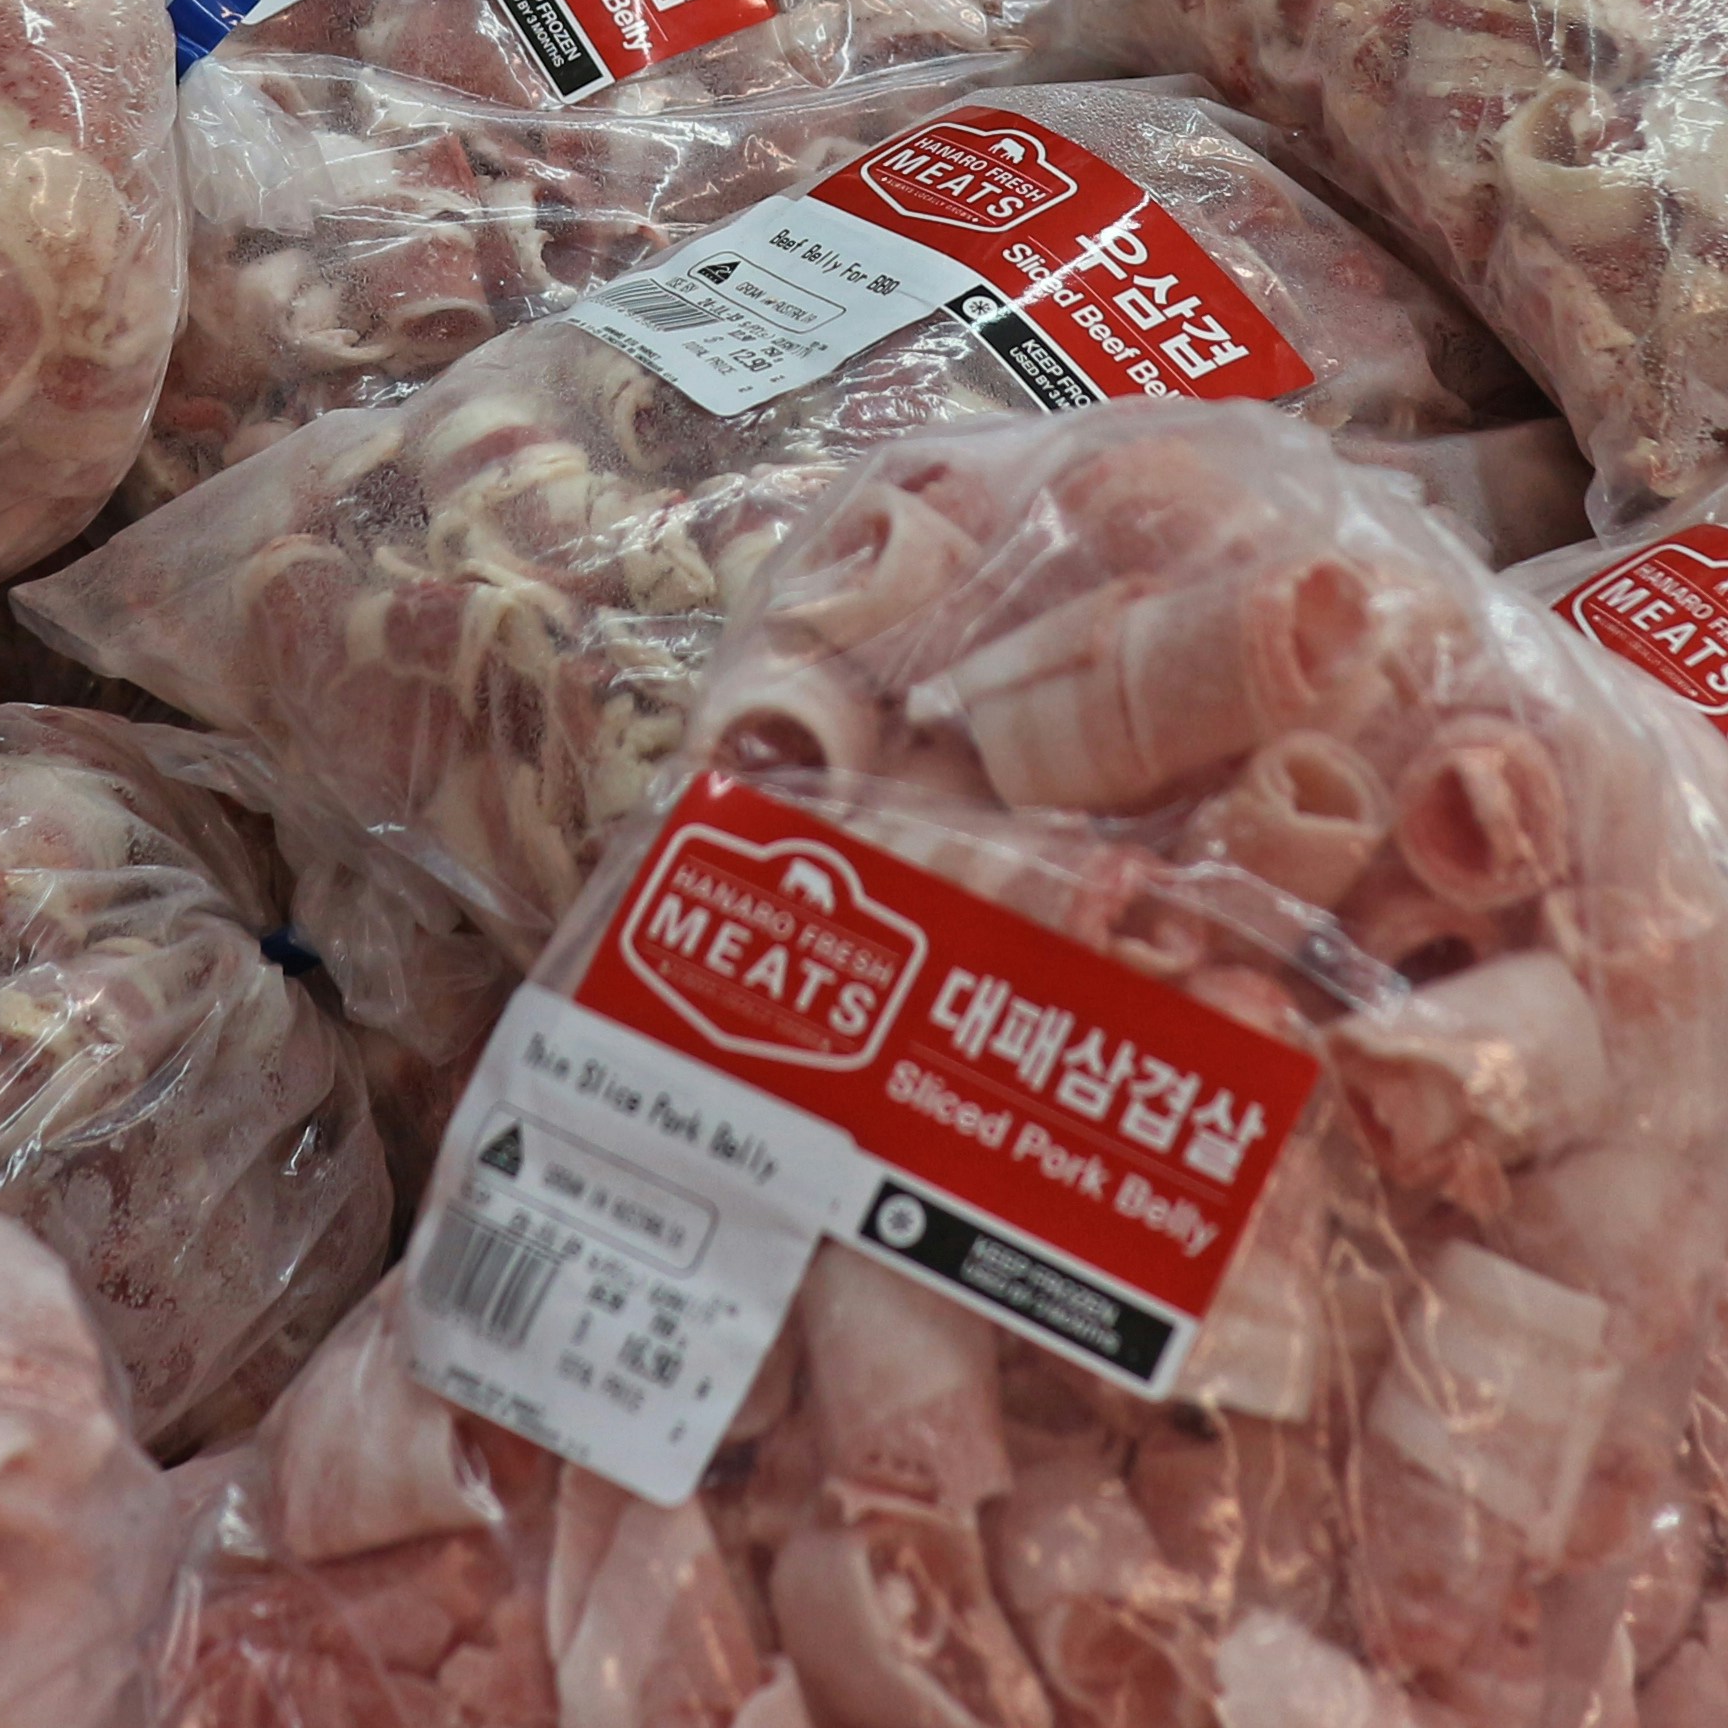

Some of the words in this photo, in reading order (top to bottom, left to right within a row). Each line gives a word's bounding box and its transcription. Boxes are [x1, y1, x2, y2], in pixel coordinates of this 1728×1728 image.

[526, 10, 538, 24] 3
[530, 20, 566, 69] MONTHS
[535, 0, 583, 62] FROZEN
[882, 148, 1025, 218] MEATS
[913, 137, 989, 172] HANARO
[985, 166, 1047, 203] FRESH
[768, 228, 809, 253] Beef
[801, 242, 843, 274] Belly
[840, 262, 869, 285] For
[866, 274, 900, 297] BBQ
[1002, 242, 1084, 308] Sliced
[1071, 303, 1142, 362] Beef
[1075, 225, 1250, 380] 우삼겹
[728, 348, 773, 373] 12.90
[1008, 346, 1039, 378] USED
[1034, 373, 1055, 391] BY
[1048, 388, 1060, 401] 3
[1022, 338, 1064, 377] KEEP
[1633, 562, 1715, 621] HANARO
[672, 862, 797, 943] HANARO
[796, 922, 897, 992] FRESH
[646, 891, 878, 1037] MEATS
[928, 965, 1269, 1186] 대패삼겹살
[575, 1058, 643, 1118] Slice
[647, 1090, 704, 1146] Pork
[707, 1120, 780, 1187] Belly
[885, 1058, 1014, 1152] Sliced
[1011, 1120, 1112, 1202] Pork
[1112, 1172, 1222, 1260] Belly
